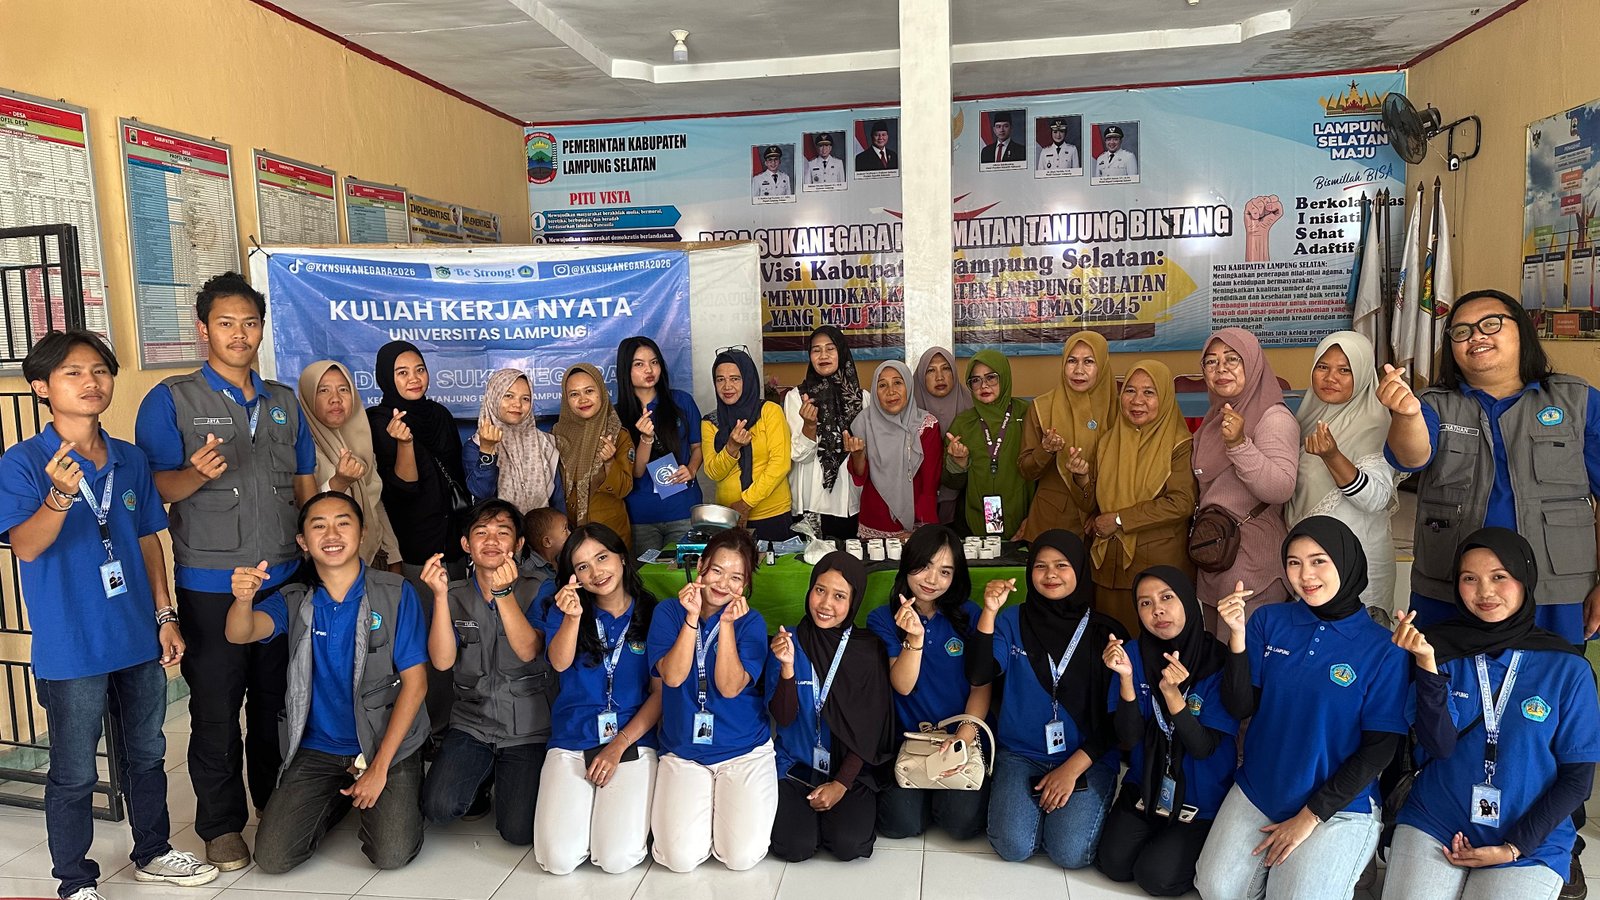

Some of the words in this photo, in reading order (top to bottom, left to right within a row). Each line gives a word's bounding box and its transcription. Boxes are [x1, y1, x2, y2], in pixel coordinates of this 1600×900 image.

[562, 137, 625, 154] PEMERINTAH
[628, 134, 687, 152] KABUPATEN
[1318, 134, 1388, 147] SELATAN
[1332, 147, 1375, 159] MAJU
[562, 159, 612, 175] LAMPUNG
[614, 157, 656, 172] SELATAN
[1313, 174, 1362, 189] Bismillah
[1364, 163, 1392, 181] BISA
[570, 192, 596, 205] PITU
[600, 191, 631, 204] VISTA
[753, 222, 896, 258] SUKANEGARA
[1024, 210, 1127, 246] TANJUNG
[1129, 204, 1233, 240] BINTANG
[306, 262, 416, 276] @KKNSUKANEGARA2026
[474, 269, 514, 278] Strong!
[571, 259, 671, 275] @KKNSUKANEGARA2026
[760, 261, 801, 282] Visi
[810, 259, 904, 283] Kabupat
[954, 256, 1053, 277] ampung
[1062, 248, 1164, 270] Selatan:
[1228, 263, 1265, 271] KABUPATEN
[997, 278, 1082, 300] LAMPUNG
[1089, 274, 1167, 295] SELATAN
[330, 301, 433, 321] KULIAH
[441, 299, 531, 320] KERJA
[538, 297, 632, 319] NYATA
[770, 308, 814, 328] YANG
[820, 308, 863, 326] MAJU
[389, 327, 501, 341] UNIVERSITAS
[504, 326, 587, 339] LAMPUNG
[1446, 425, 1468, 433] NATHAN
